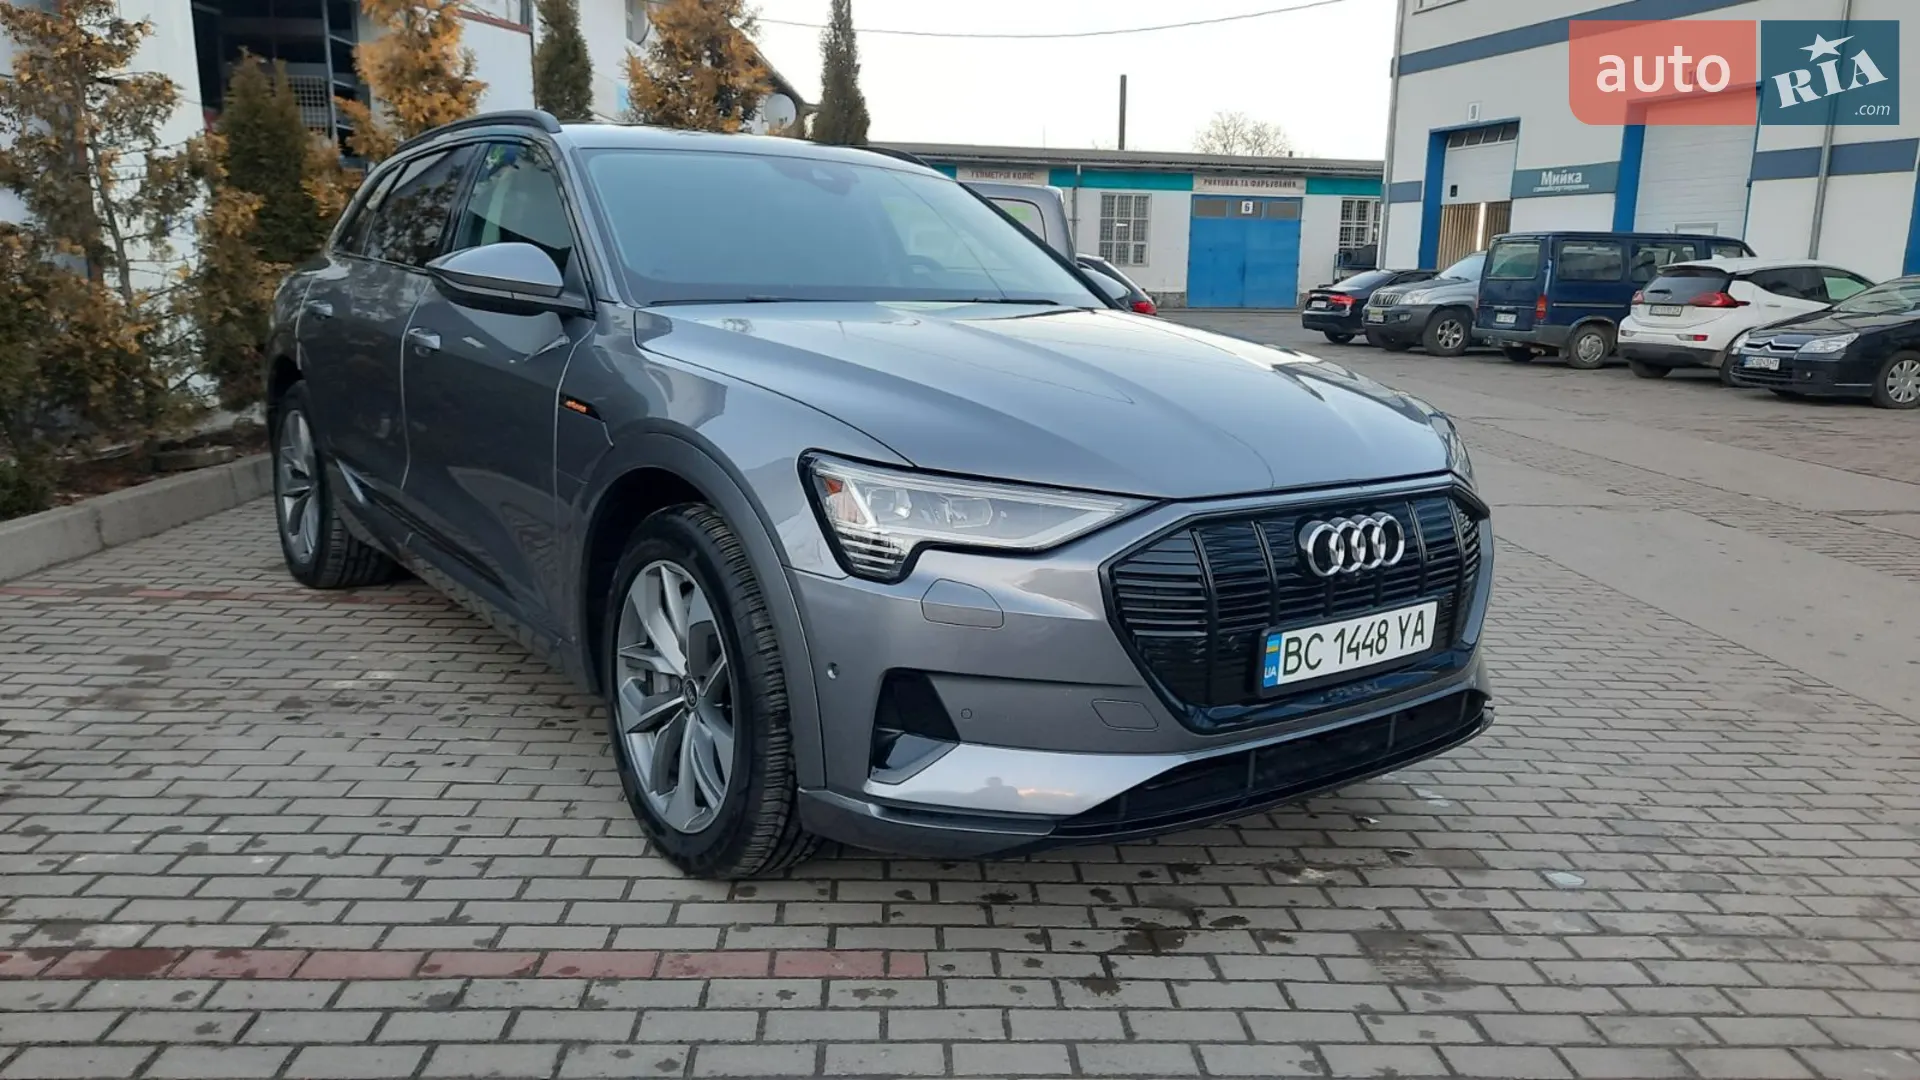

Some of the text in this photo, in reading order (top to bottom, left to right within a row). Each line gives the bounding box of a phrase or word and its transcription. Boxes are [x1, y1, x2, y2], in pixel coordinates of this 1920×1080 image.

[1540, 169, 1582, 186] Мийка
[1244, 202, 1251, 212] 6
[1282, 609, 1425, 676] BC 1448 YA
[1264, 665, 1277, 679] UA
